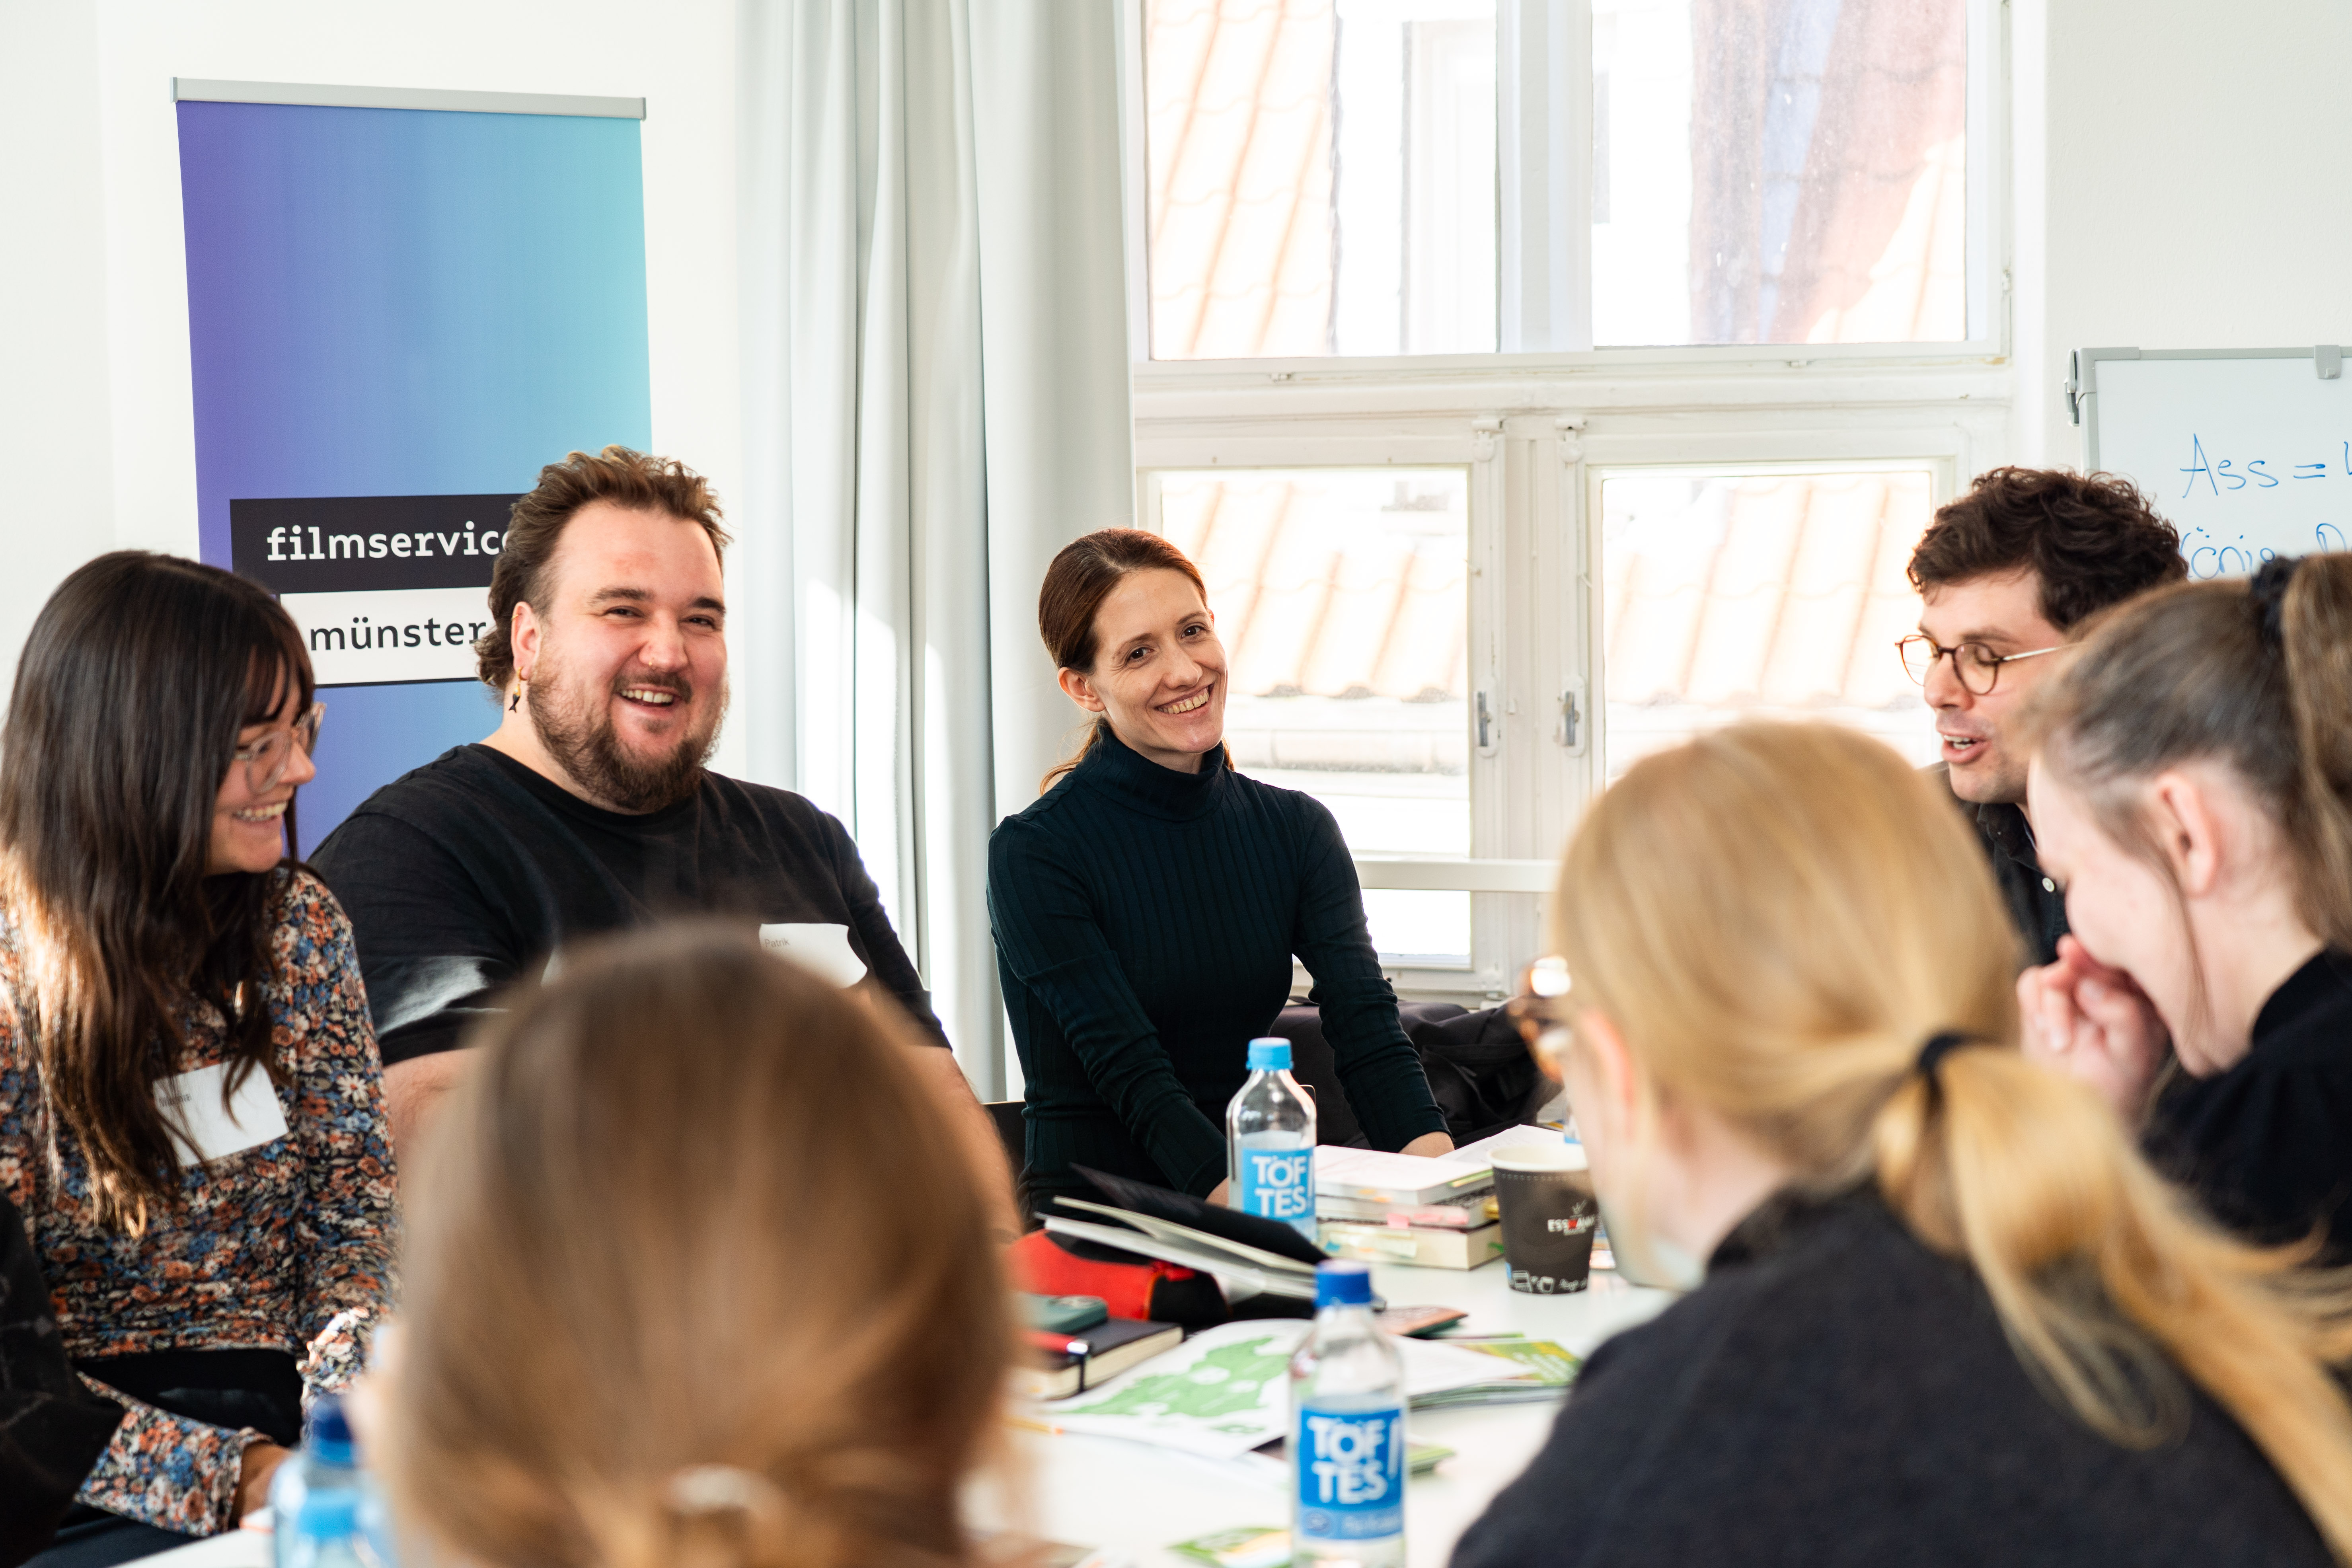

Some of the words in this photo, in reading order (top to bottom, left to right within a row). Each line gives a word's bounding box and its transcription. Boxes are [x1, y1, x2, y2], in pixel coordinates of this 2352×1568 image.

[267, 520, 509, 561] filmservic
[310, 617, 486, 651] münster
[1251, 1155, 1307, 1188] TÖF
[1254, 1185, 1307, 1217] TES
[1311, 1459, 1388, 1504] TES
